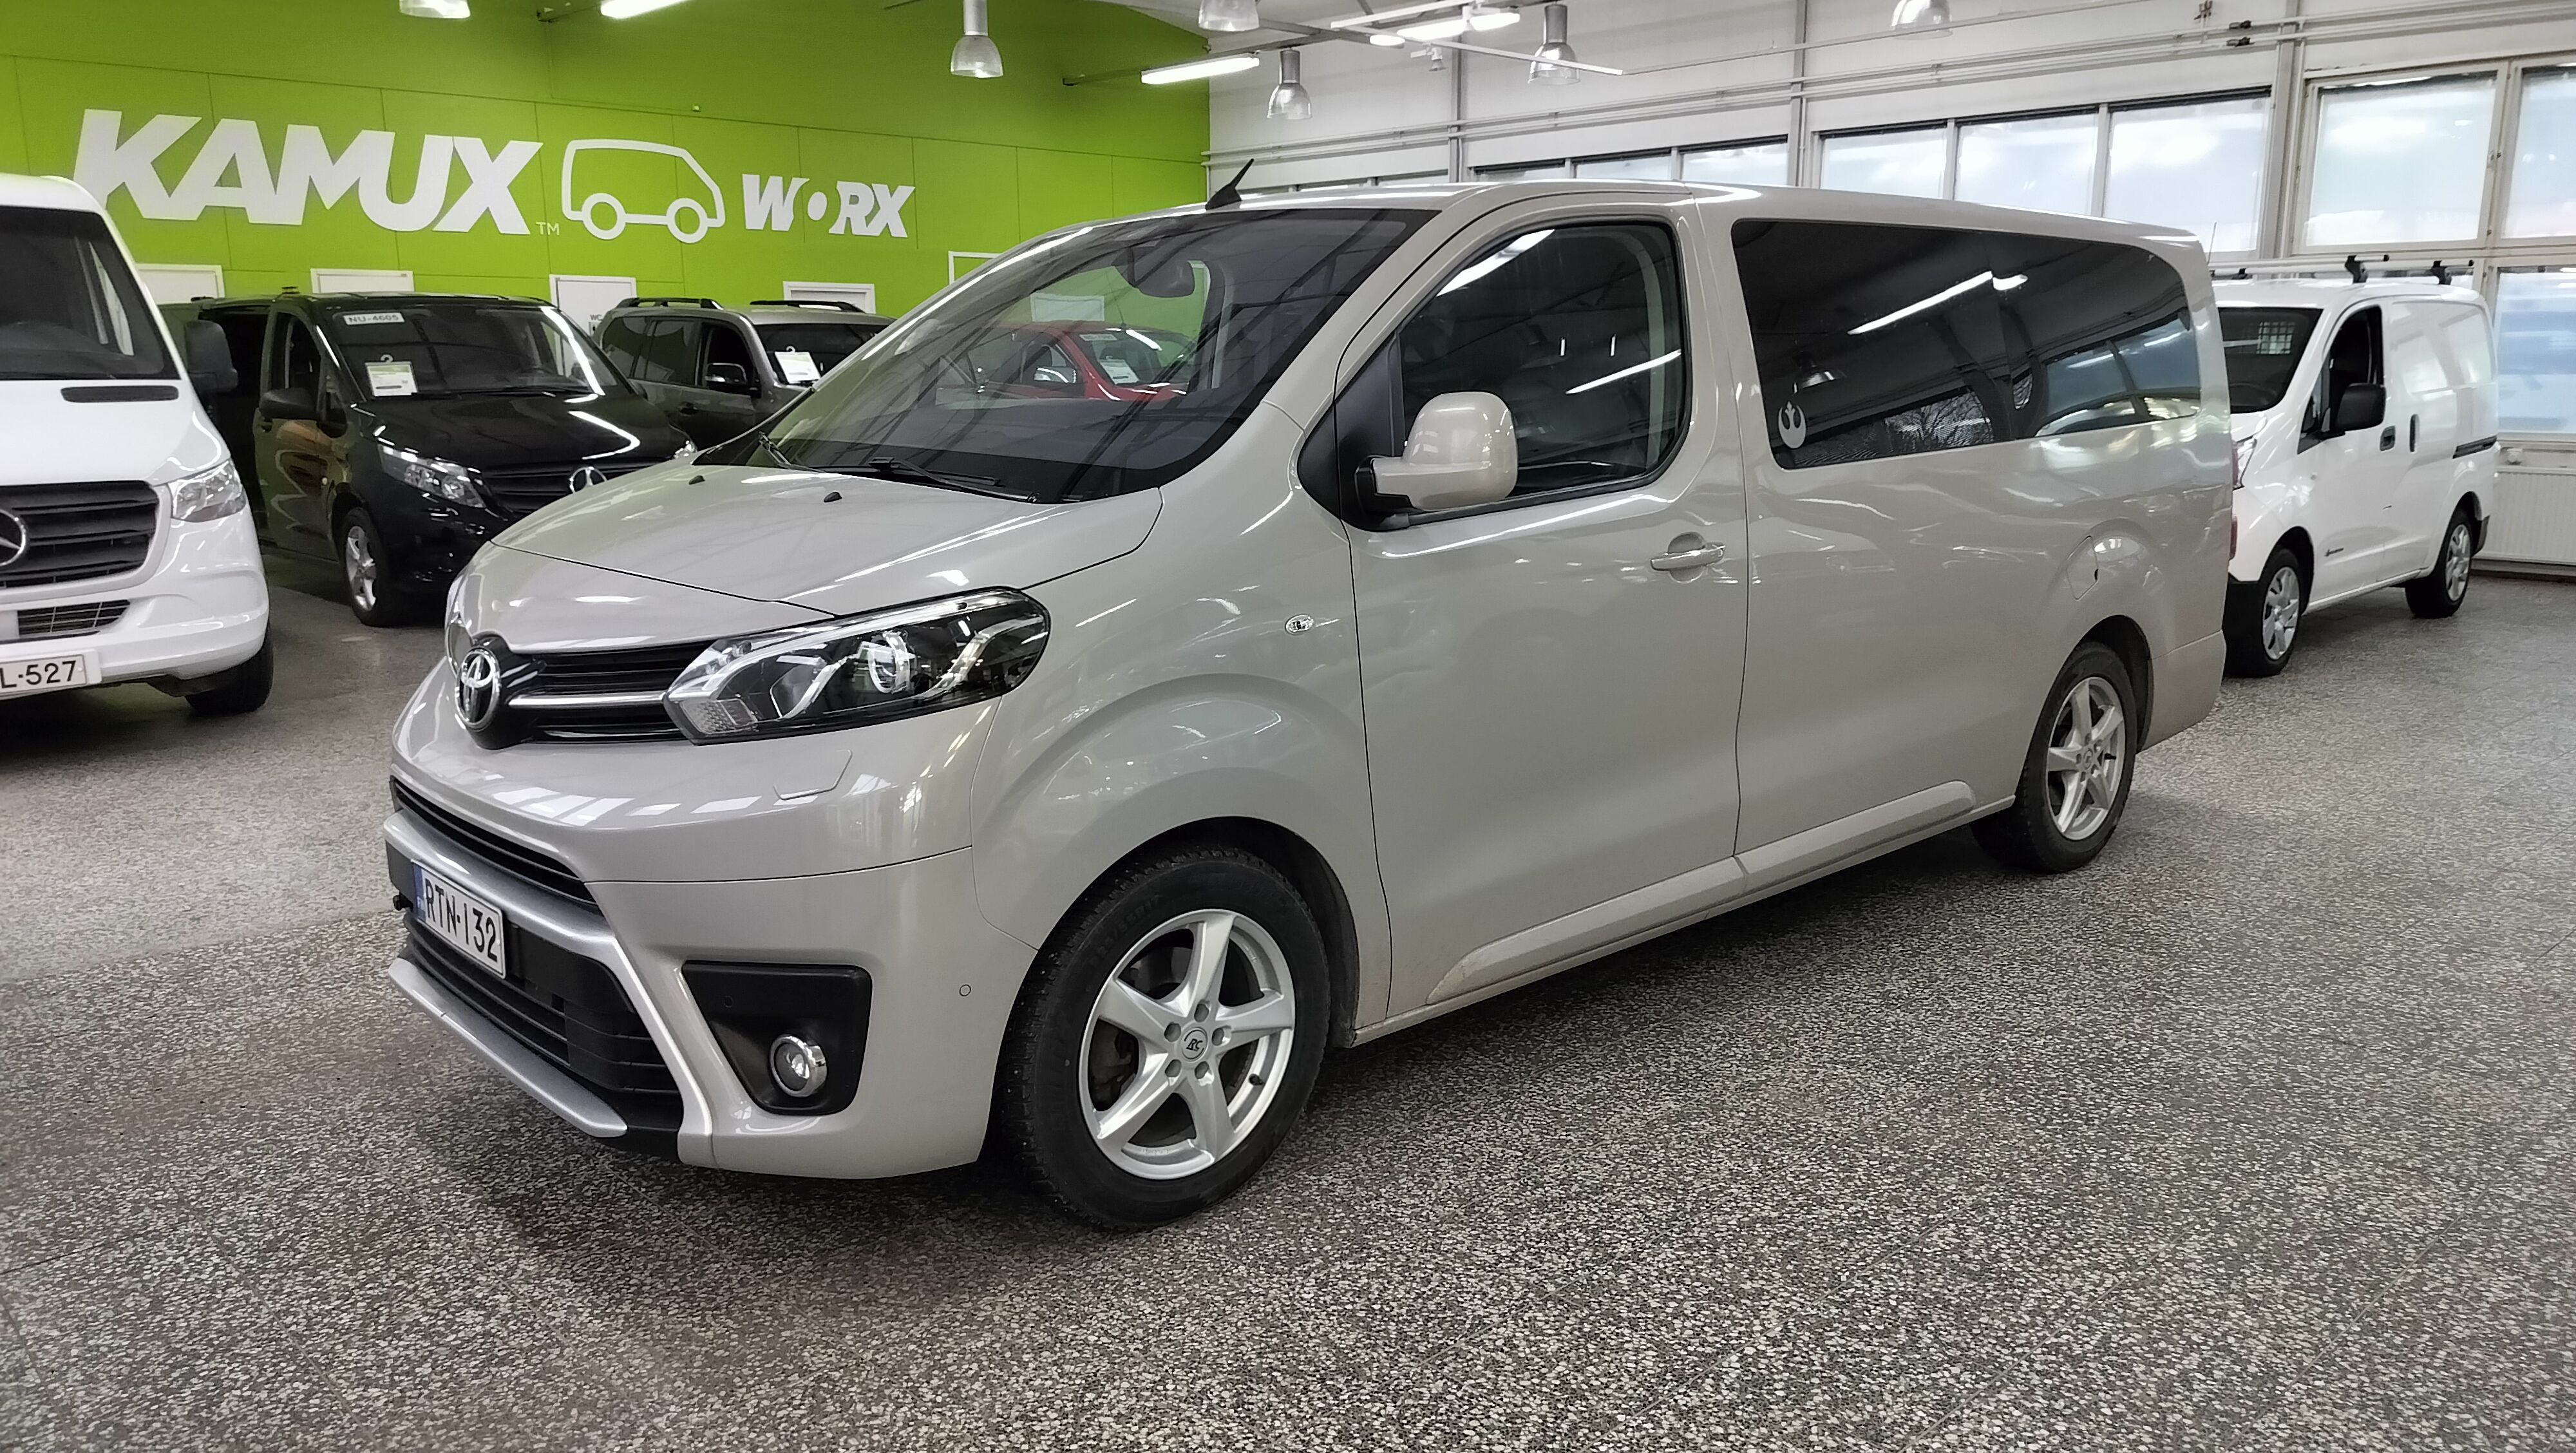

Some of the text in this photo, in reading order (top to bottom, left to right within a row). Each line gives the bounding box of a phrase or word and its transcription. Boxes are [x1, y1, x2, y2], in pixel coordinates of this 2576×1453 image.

[73, 108, 560, 236] KAMUX TM
[425, 878, 498, 963] RTN-132
[1186, 1038, 1203, 1050] RC
